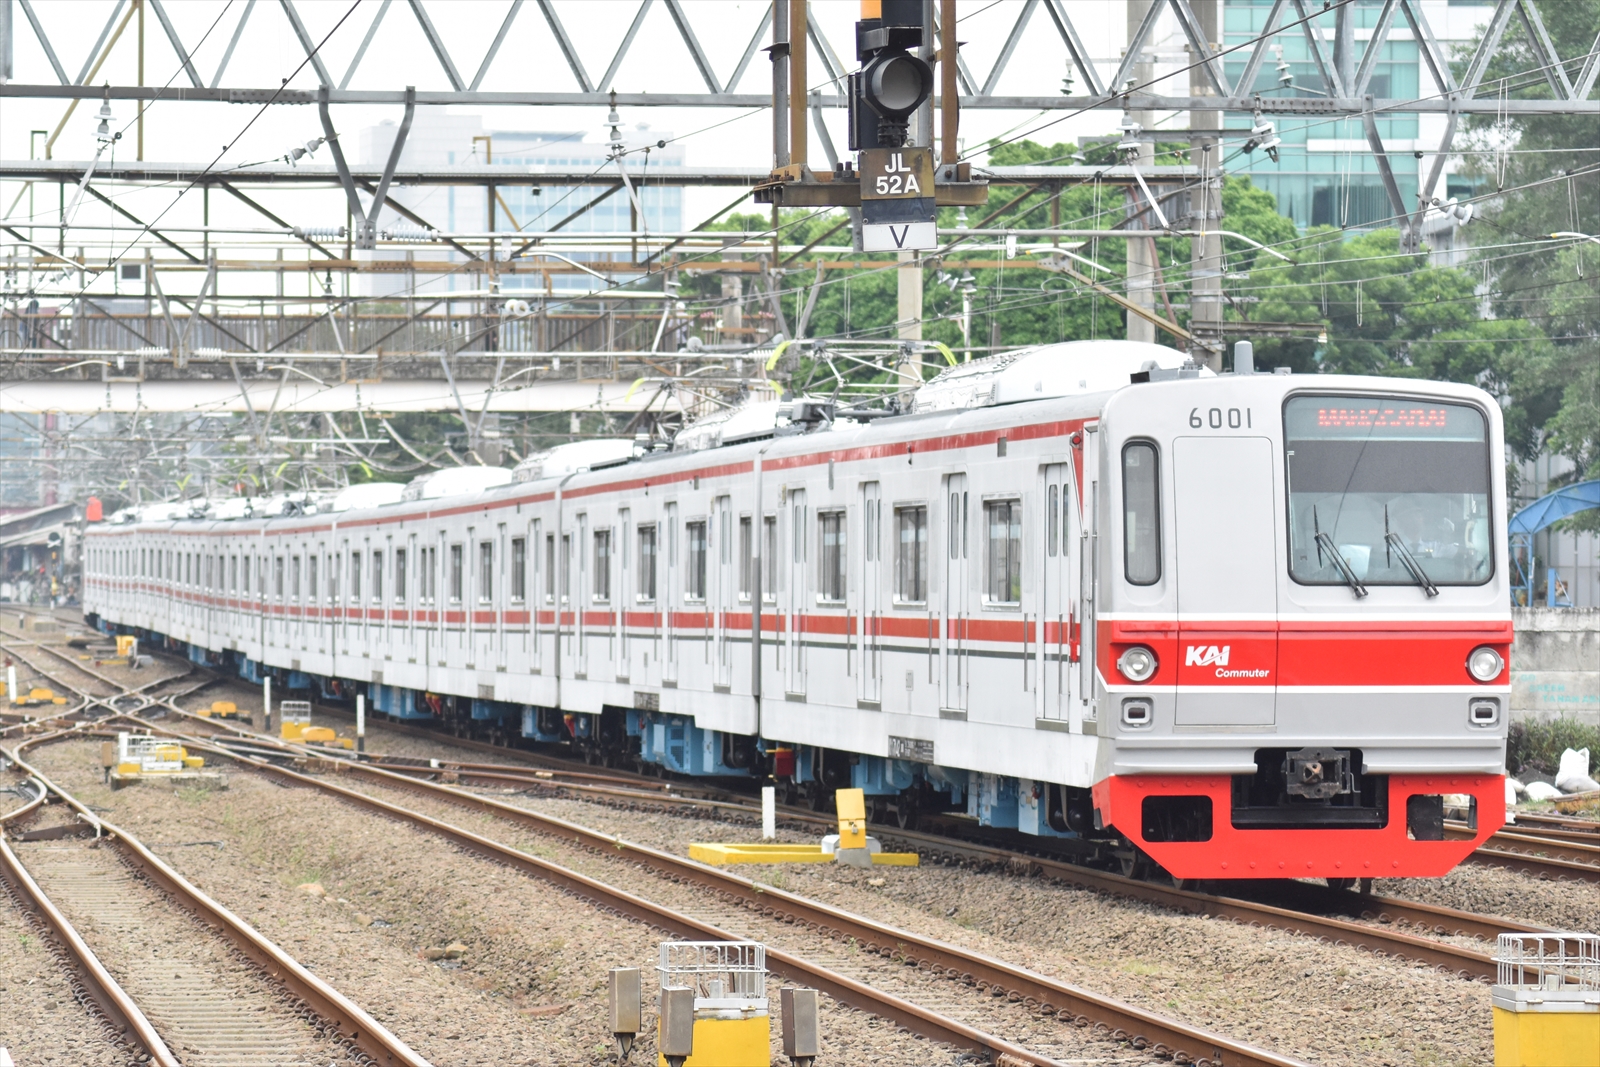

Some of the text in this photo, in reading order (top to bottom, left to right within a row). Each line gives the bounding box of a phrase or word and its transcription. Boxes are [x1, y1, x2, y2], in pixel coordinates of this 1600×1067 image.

[885, 153, 911, 173] JL
[876, 174, 920, 194] 52A
[889, 225, 909, 248] V
[1189, 408, 1251, 428] 6001
[1185, 646, 1230, 666] KAI
[1215, 668, 1269, 678] Commuter
